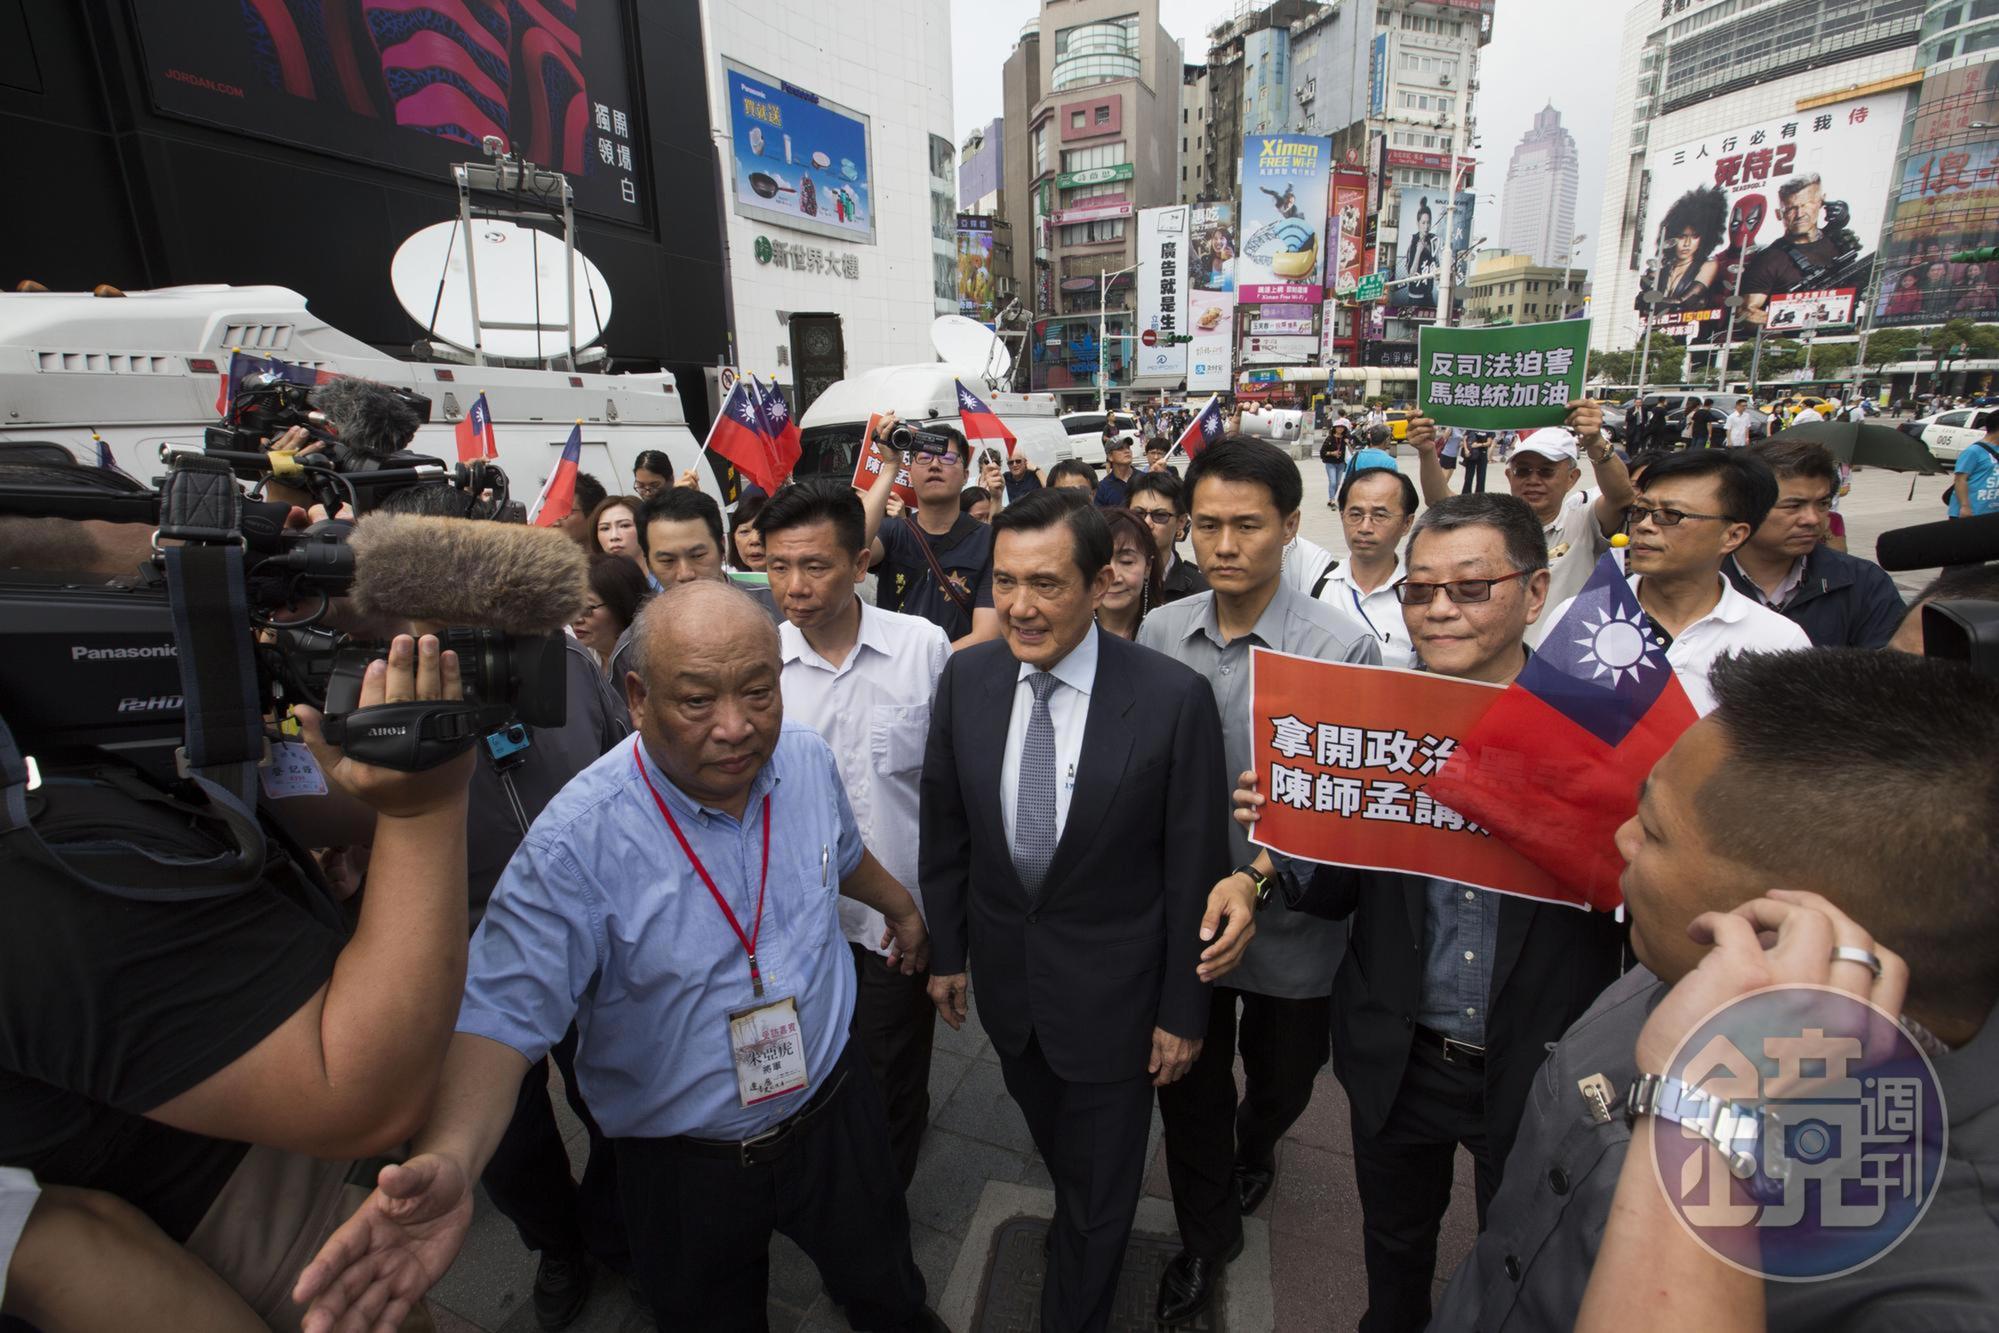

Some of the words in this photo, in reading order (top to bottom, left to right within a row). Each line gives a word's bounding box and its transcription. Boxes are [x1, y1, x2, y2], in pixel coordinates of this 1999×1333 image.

[165, 69, 244, 98] JORDAN.COM
[594, 102, 615, 166] 獨領
[1260, 139, 1318, 157] Ximen
[1672, 107, 1869, 166] 三人行必有我侍
[613, 109, 635, 203] 開場白
[1259, 156, 1289, 168] FREE
[1714, 142, 1797, 189] 死侍2
[1732, 183, 1759, 193] DEADPOOL
[771, 239, 859, 280] 新世界大樓
[1160, 242, 1177, 348] 廣告就是生
[1429, 347, 1574, 379] 反司法迫害
[1428, 380, 1570, 407] 馬總統加油
[1937, 435, 1952, 446] 005
[71, 643, 177, 661] Panasonic
